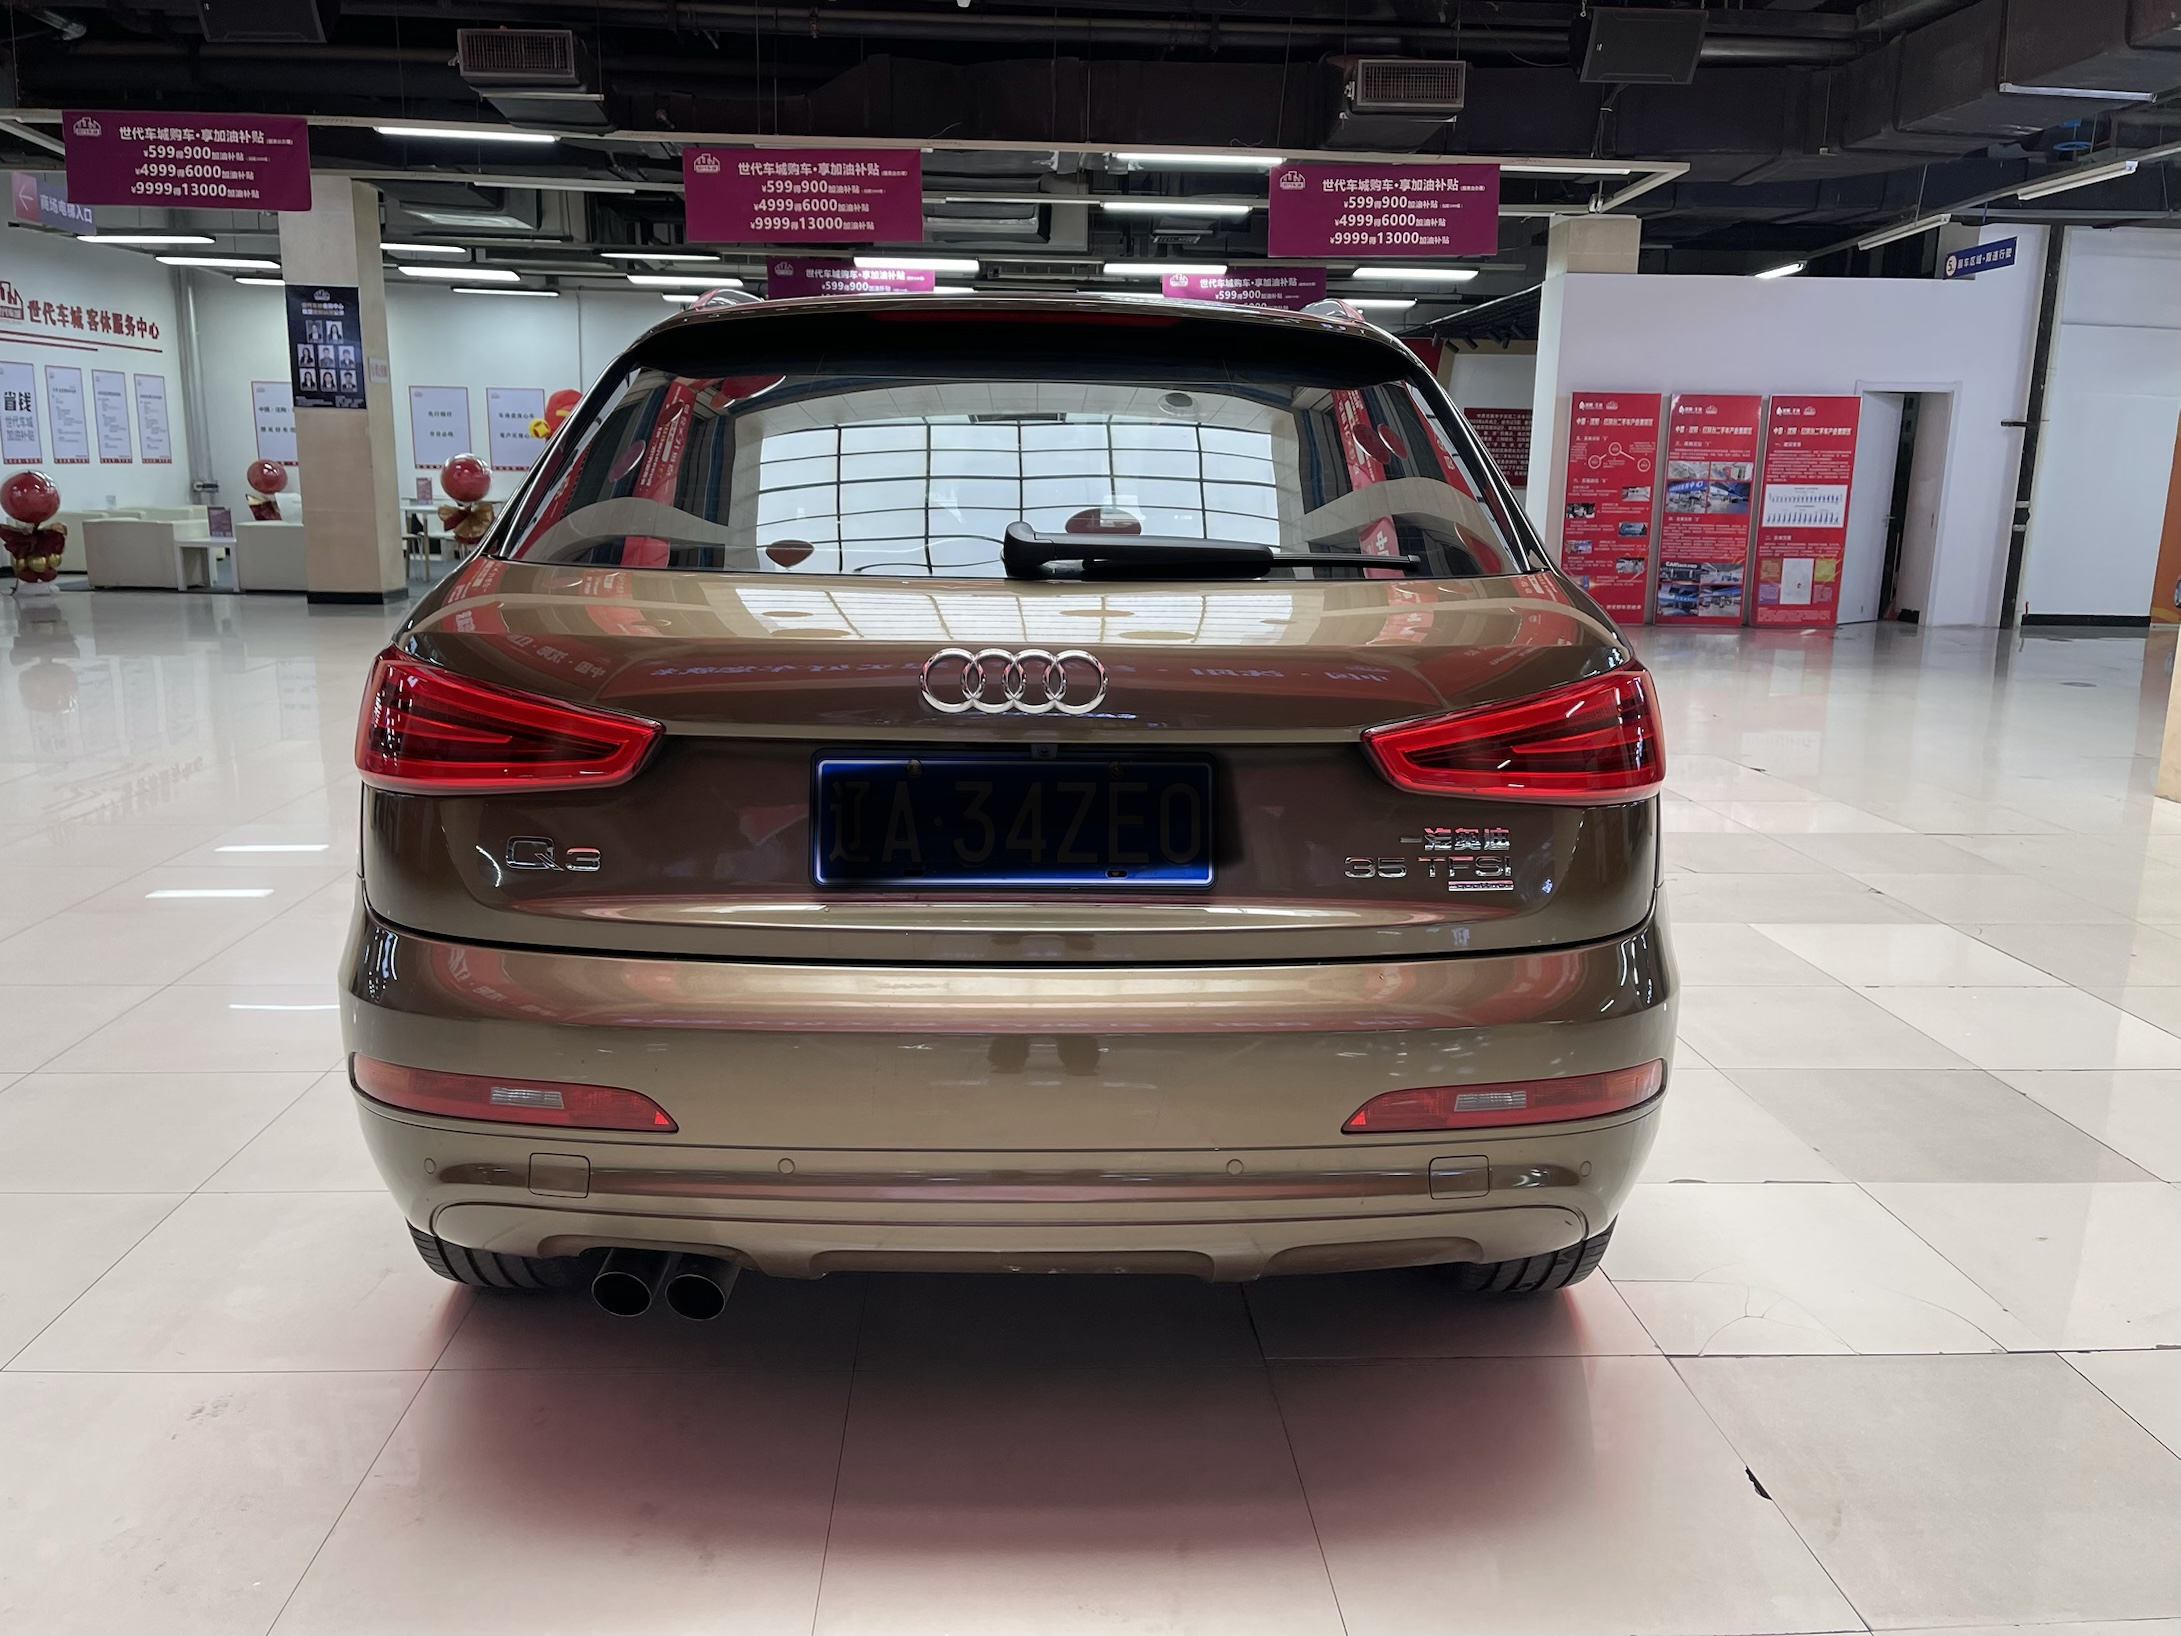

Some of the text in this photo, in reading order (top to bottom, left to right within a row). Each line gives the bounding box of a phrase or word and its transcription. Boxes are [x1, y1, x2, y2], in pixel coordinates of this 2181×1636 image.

[119, 126, 265, 145] 世代车城购车·享加油补贴
[737, 162, 880, 177] 世代车城购车·享加油补贴
[1322, 178, 1459, 192] 世代车城购车·享加油补贴
[27, 299, 160, 340] 世代车城 客休服务中心
[4, 391, 32, 412] 省钱
[505, 835, 601, 872] Q3
[1344, 856, 1512, 879] 35 TFSI
